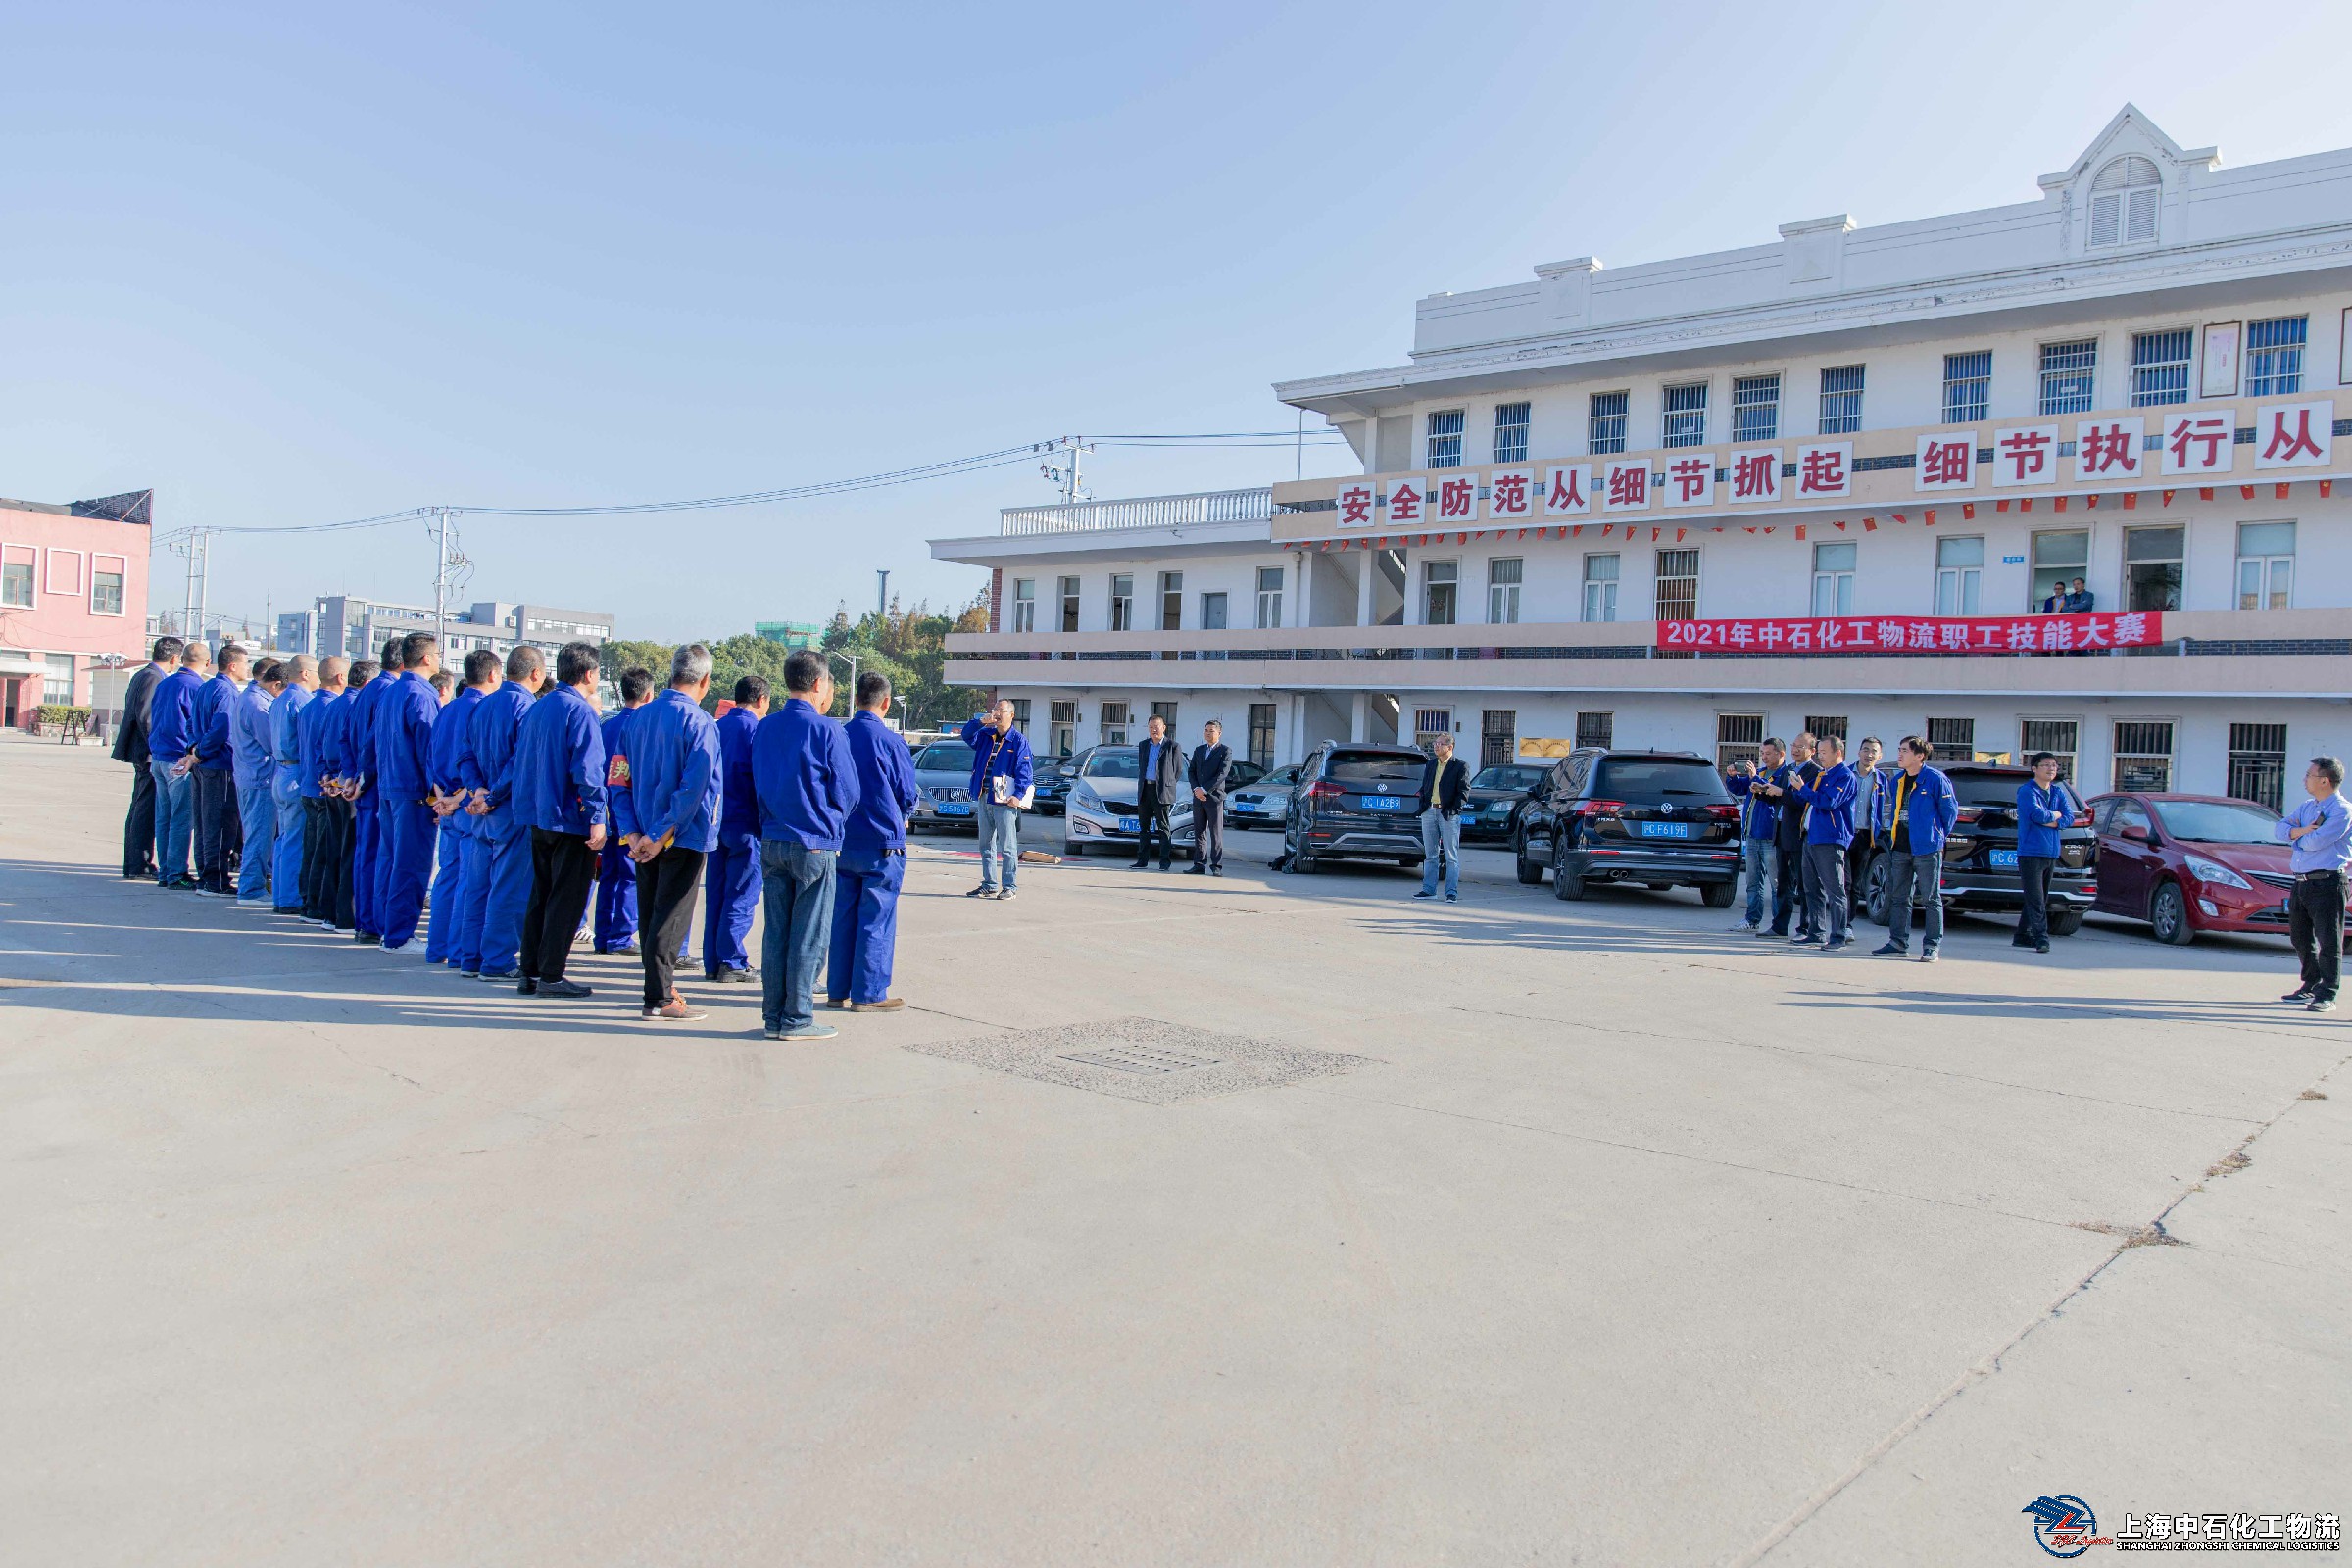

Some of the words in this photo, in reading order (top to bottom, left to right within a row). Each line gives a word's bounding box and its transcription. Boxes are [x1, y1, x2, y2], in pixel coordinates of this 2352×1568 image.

[1341, 450, 1846, 524] 安全防范从细节抓起
[1923, 409, 2324, 484] 细节执行从
[1667, 612, 2146, 650] 2021年中石化工物流职工技能大赛
